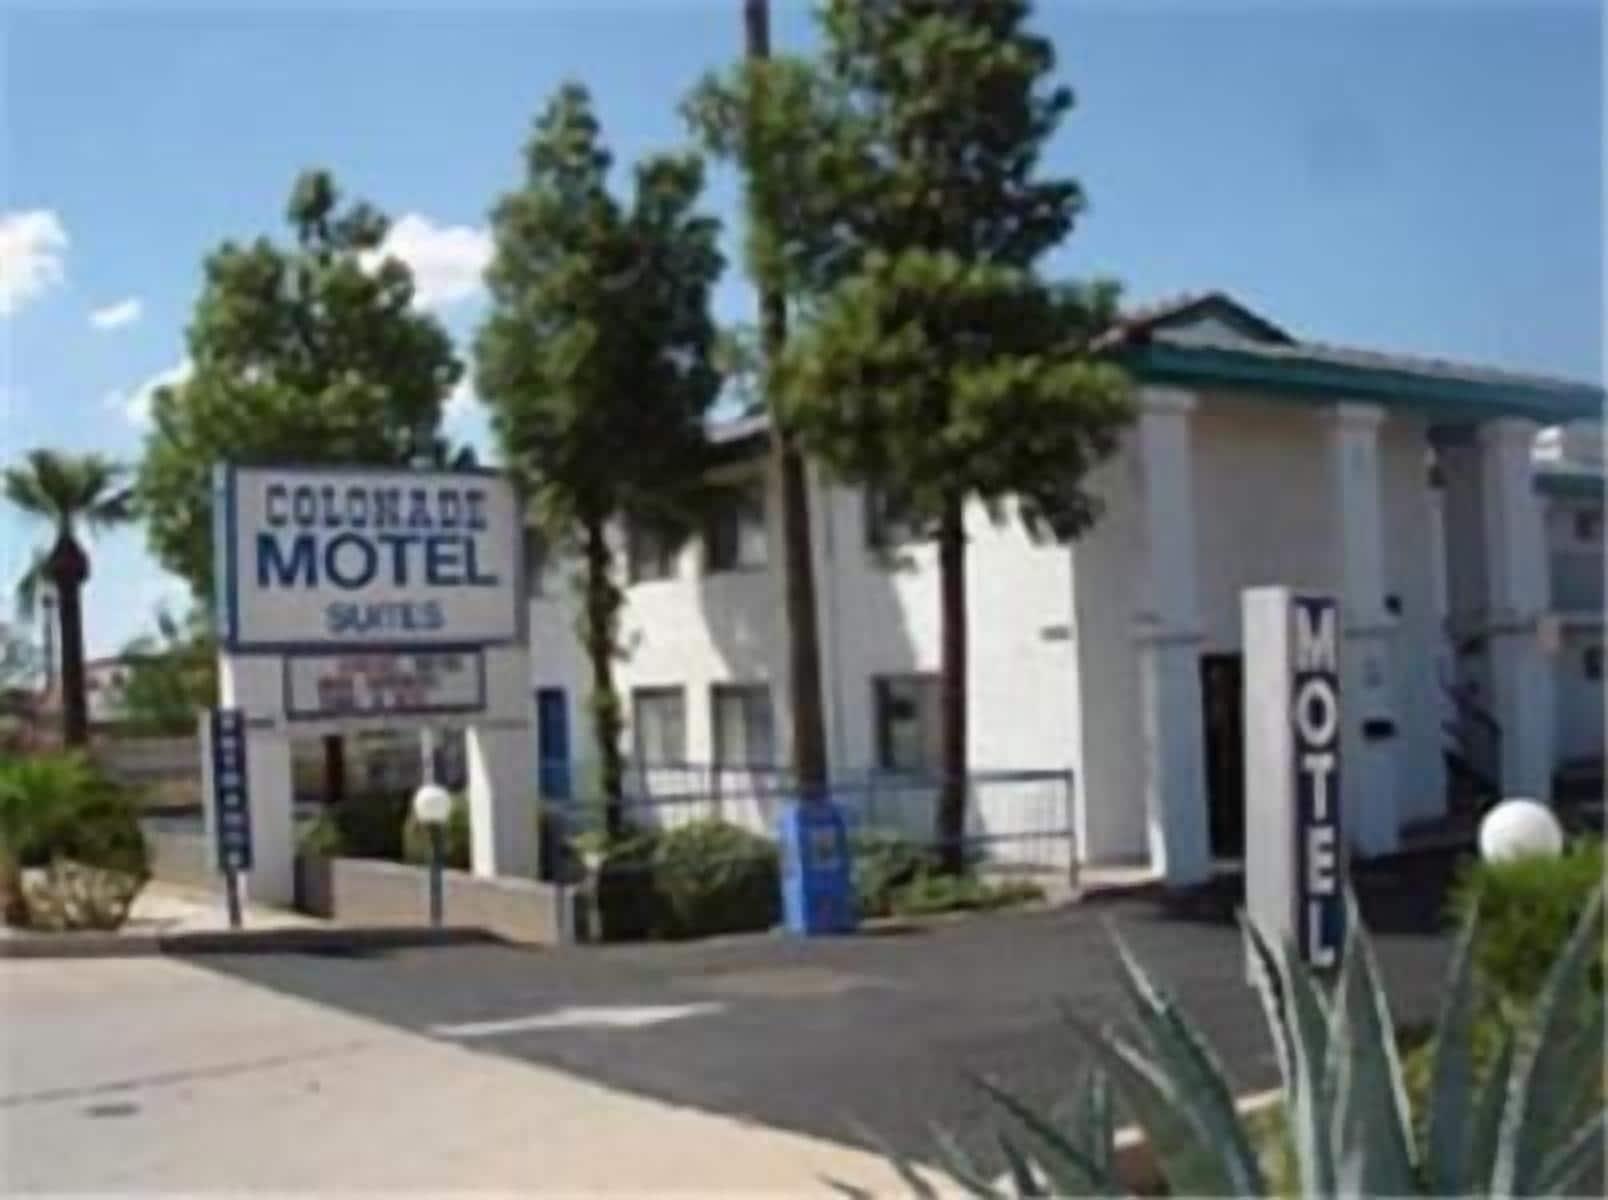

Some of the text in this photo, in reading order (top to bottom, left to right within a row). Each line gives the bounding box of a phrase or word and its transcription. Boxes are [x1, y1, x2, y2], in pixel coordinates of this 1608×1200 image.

[265, 483, 487, 530] COLONADE
[256, 531, 499, 590] MOTEL
[1296, 604, 1338, 968] MOTEL
